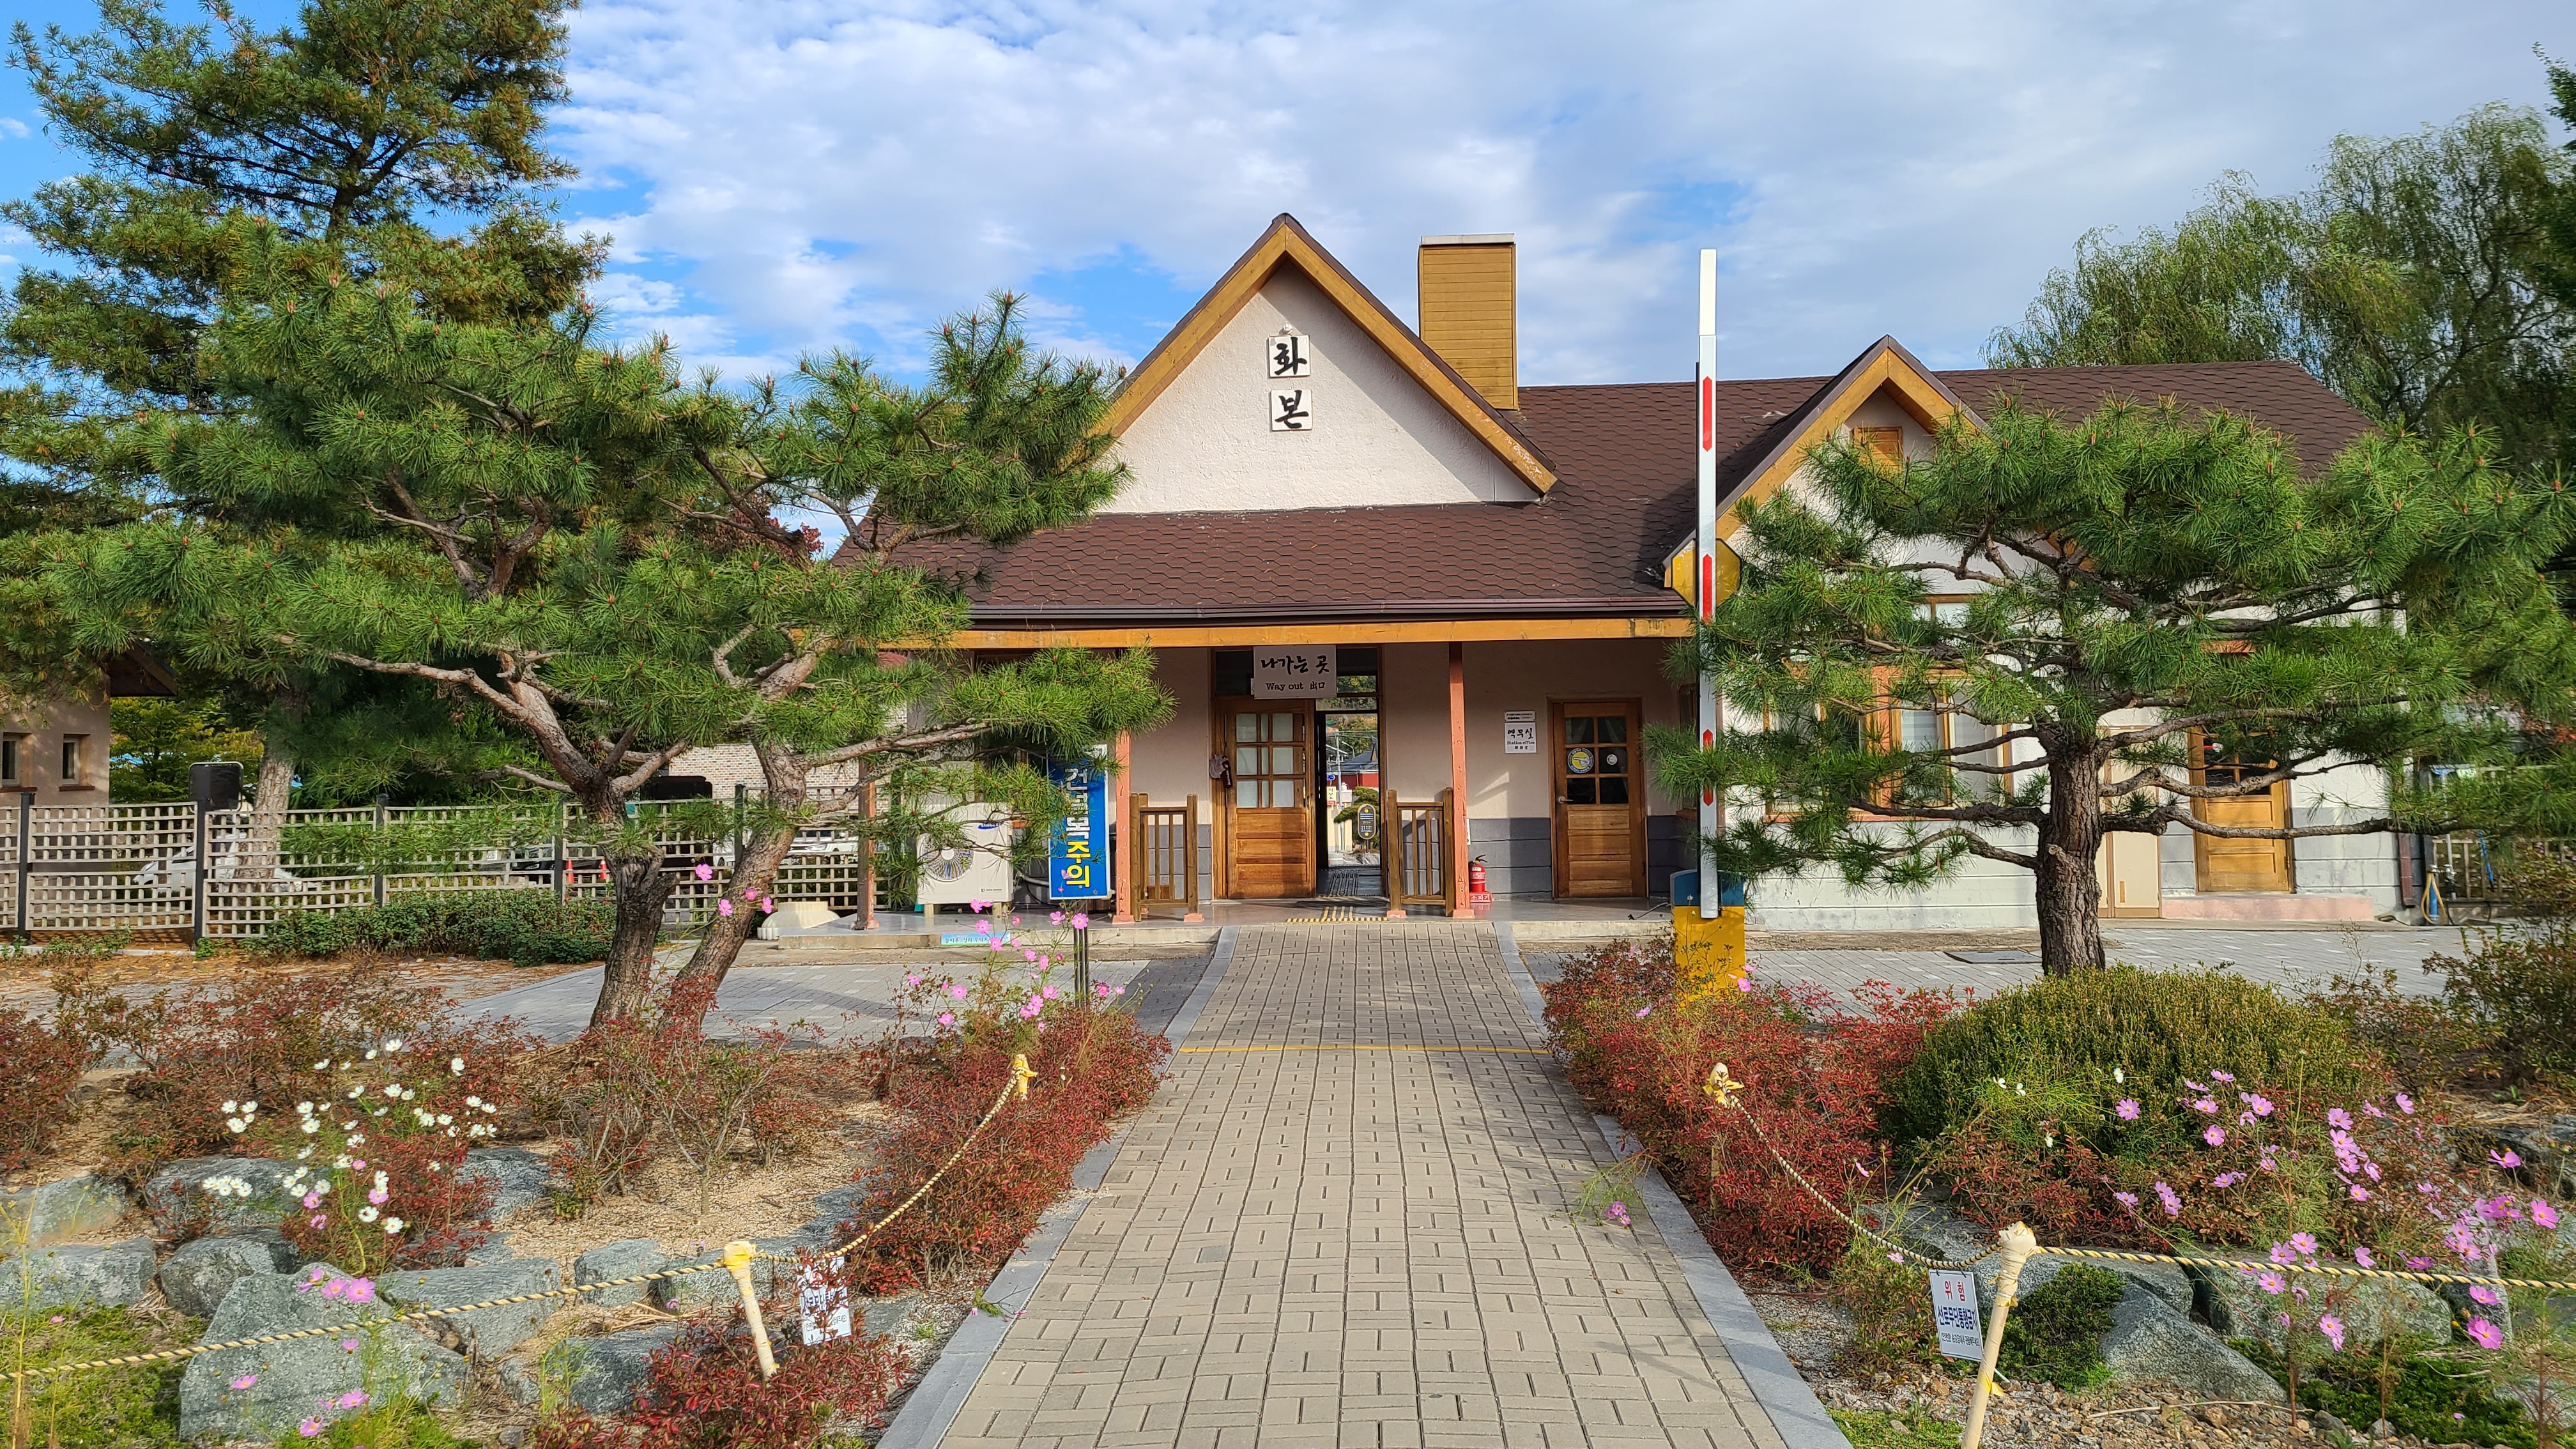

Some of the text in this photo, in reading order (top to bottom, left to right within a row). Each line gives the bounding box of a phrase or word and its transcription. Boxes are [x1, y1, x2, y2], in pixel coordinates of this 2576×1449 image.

[1274, 337, 1309, 429] 화본
[1261, 655, 1330, 675] 나가는 곳
[1265, 682, 1304, 691] Way out
[1310, 681, 1326, 691] 出口
[1507, 727, 1534, 739] 역무실
[1938, 1305, 1979, 1331] 선로무단통행금지
